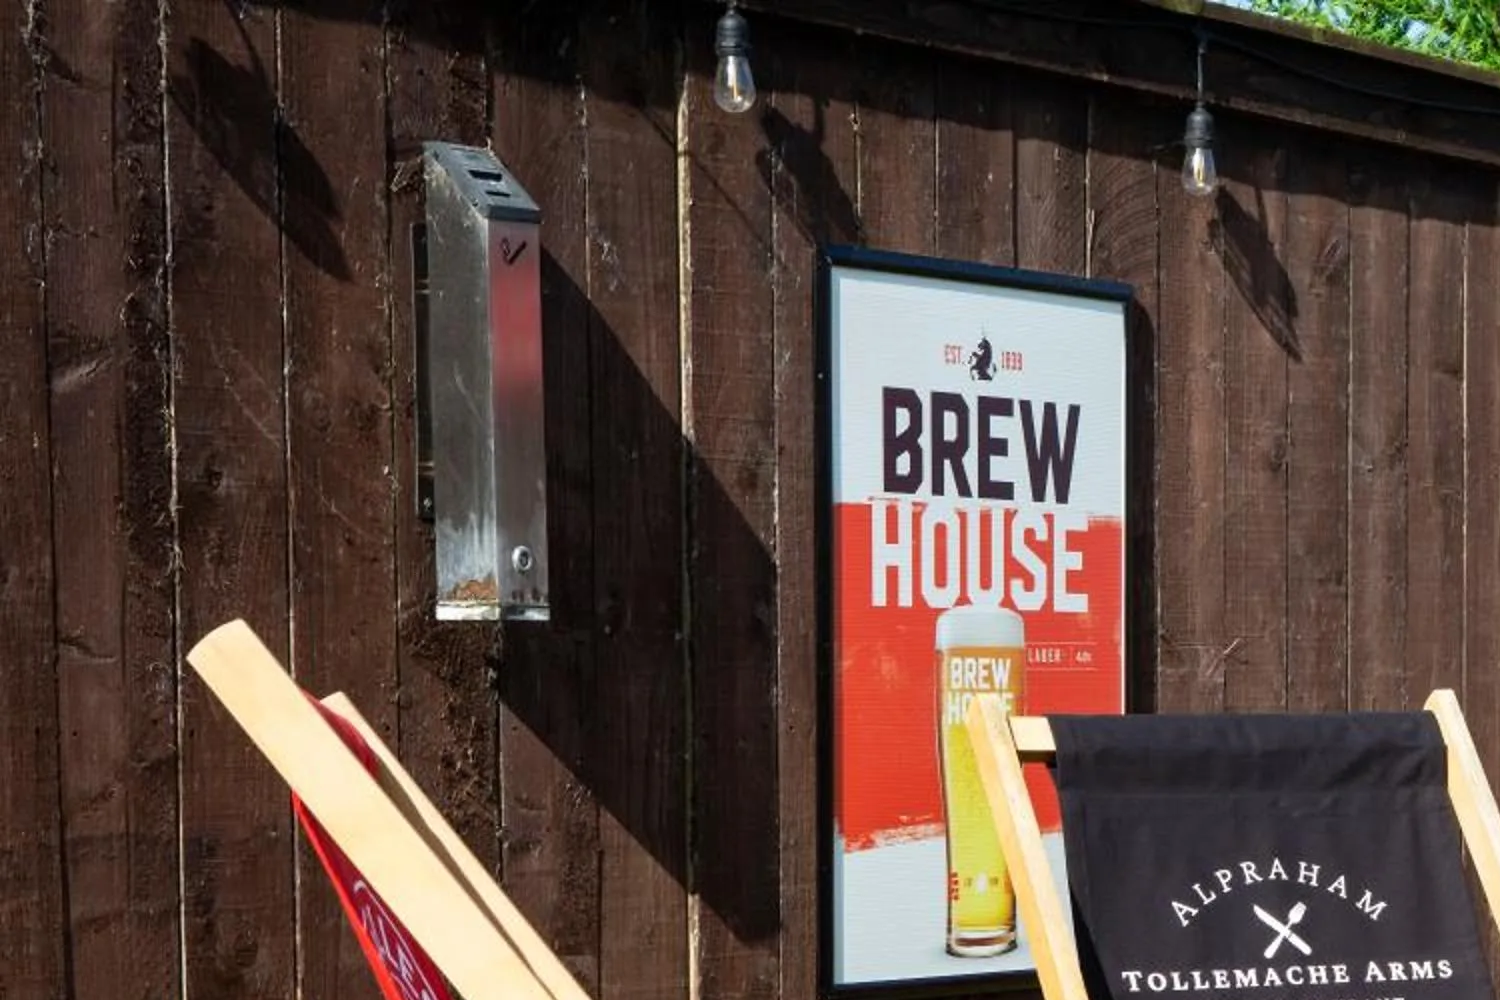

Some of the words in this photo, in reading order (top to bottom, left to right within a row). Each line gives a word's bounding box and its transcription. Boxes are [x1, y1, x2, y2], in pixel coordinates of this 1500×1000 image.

[881, 386, 1081, 505] BREW
[868, 497, 1090, 614] HOUSE
[949, 656, 1012, 690] BREW
[1171, 858, 1388, 927] ALPRAHAM
[1121, 964, 1350, 993] TOLLEMACHE
[1364, 959, 1454, 982] ARMS
